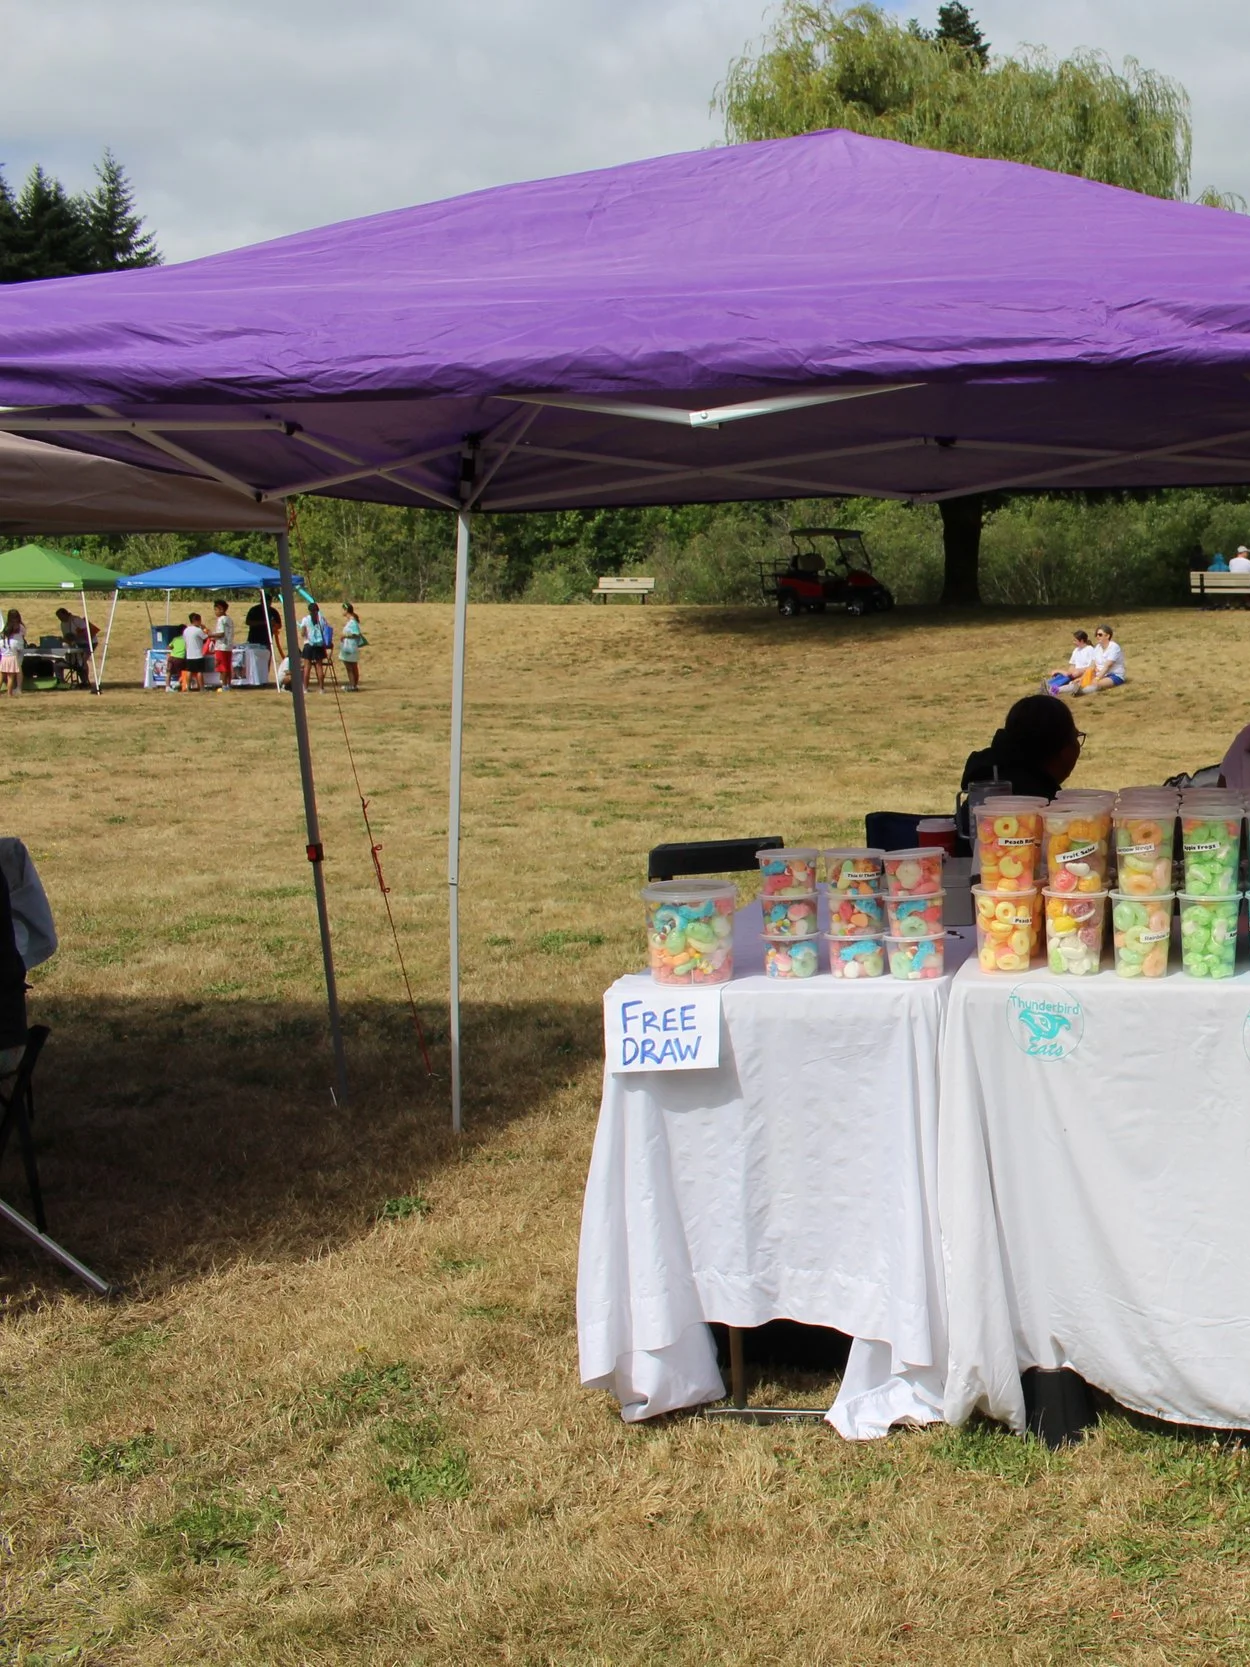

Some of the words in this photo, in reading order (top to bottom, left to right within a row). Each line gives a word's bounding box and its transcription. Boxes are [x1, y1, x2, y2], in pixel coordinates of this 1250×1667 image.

[1062, 852, 1079, 860] Fruit
[1080, 846, 1095, 855] Salad
[1009, 995, 1080, 1015] Thunderbird
[622, 1000, 696, 1034] FREE
[622, 1035, 702, 1066] DRAW
[1026, 1036, 1063, 1056] Eats
